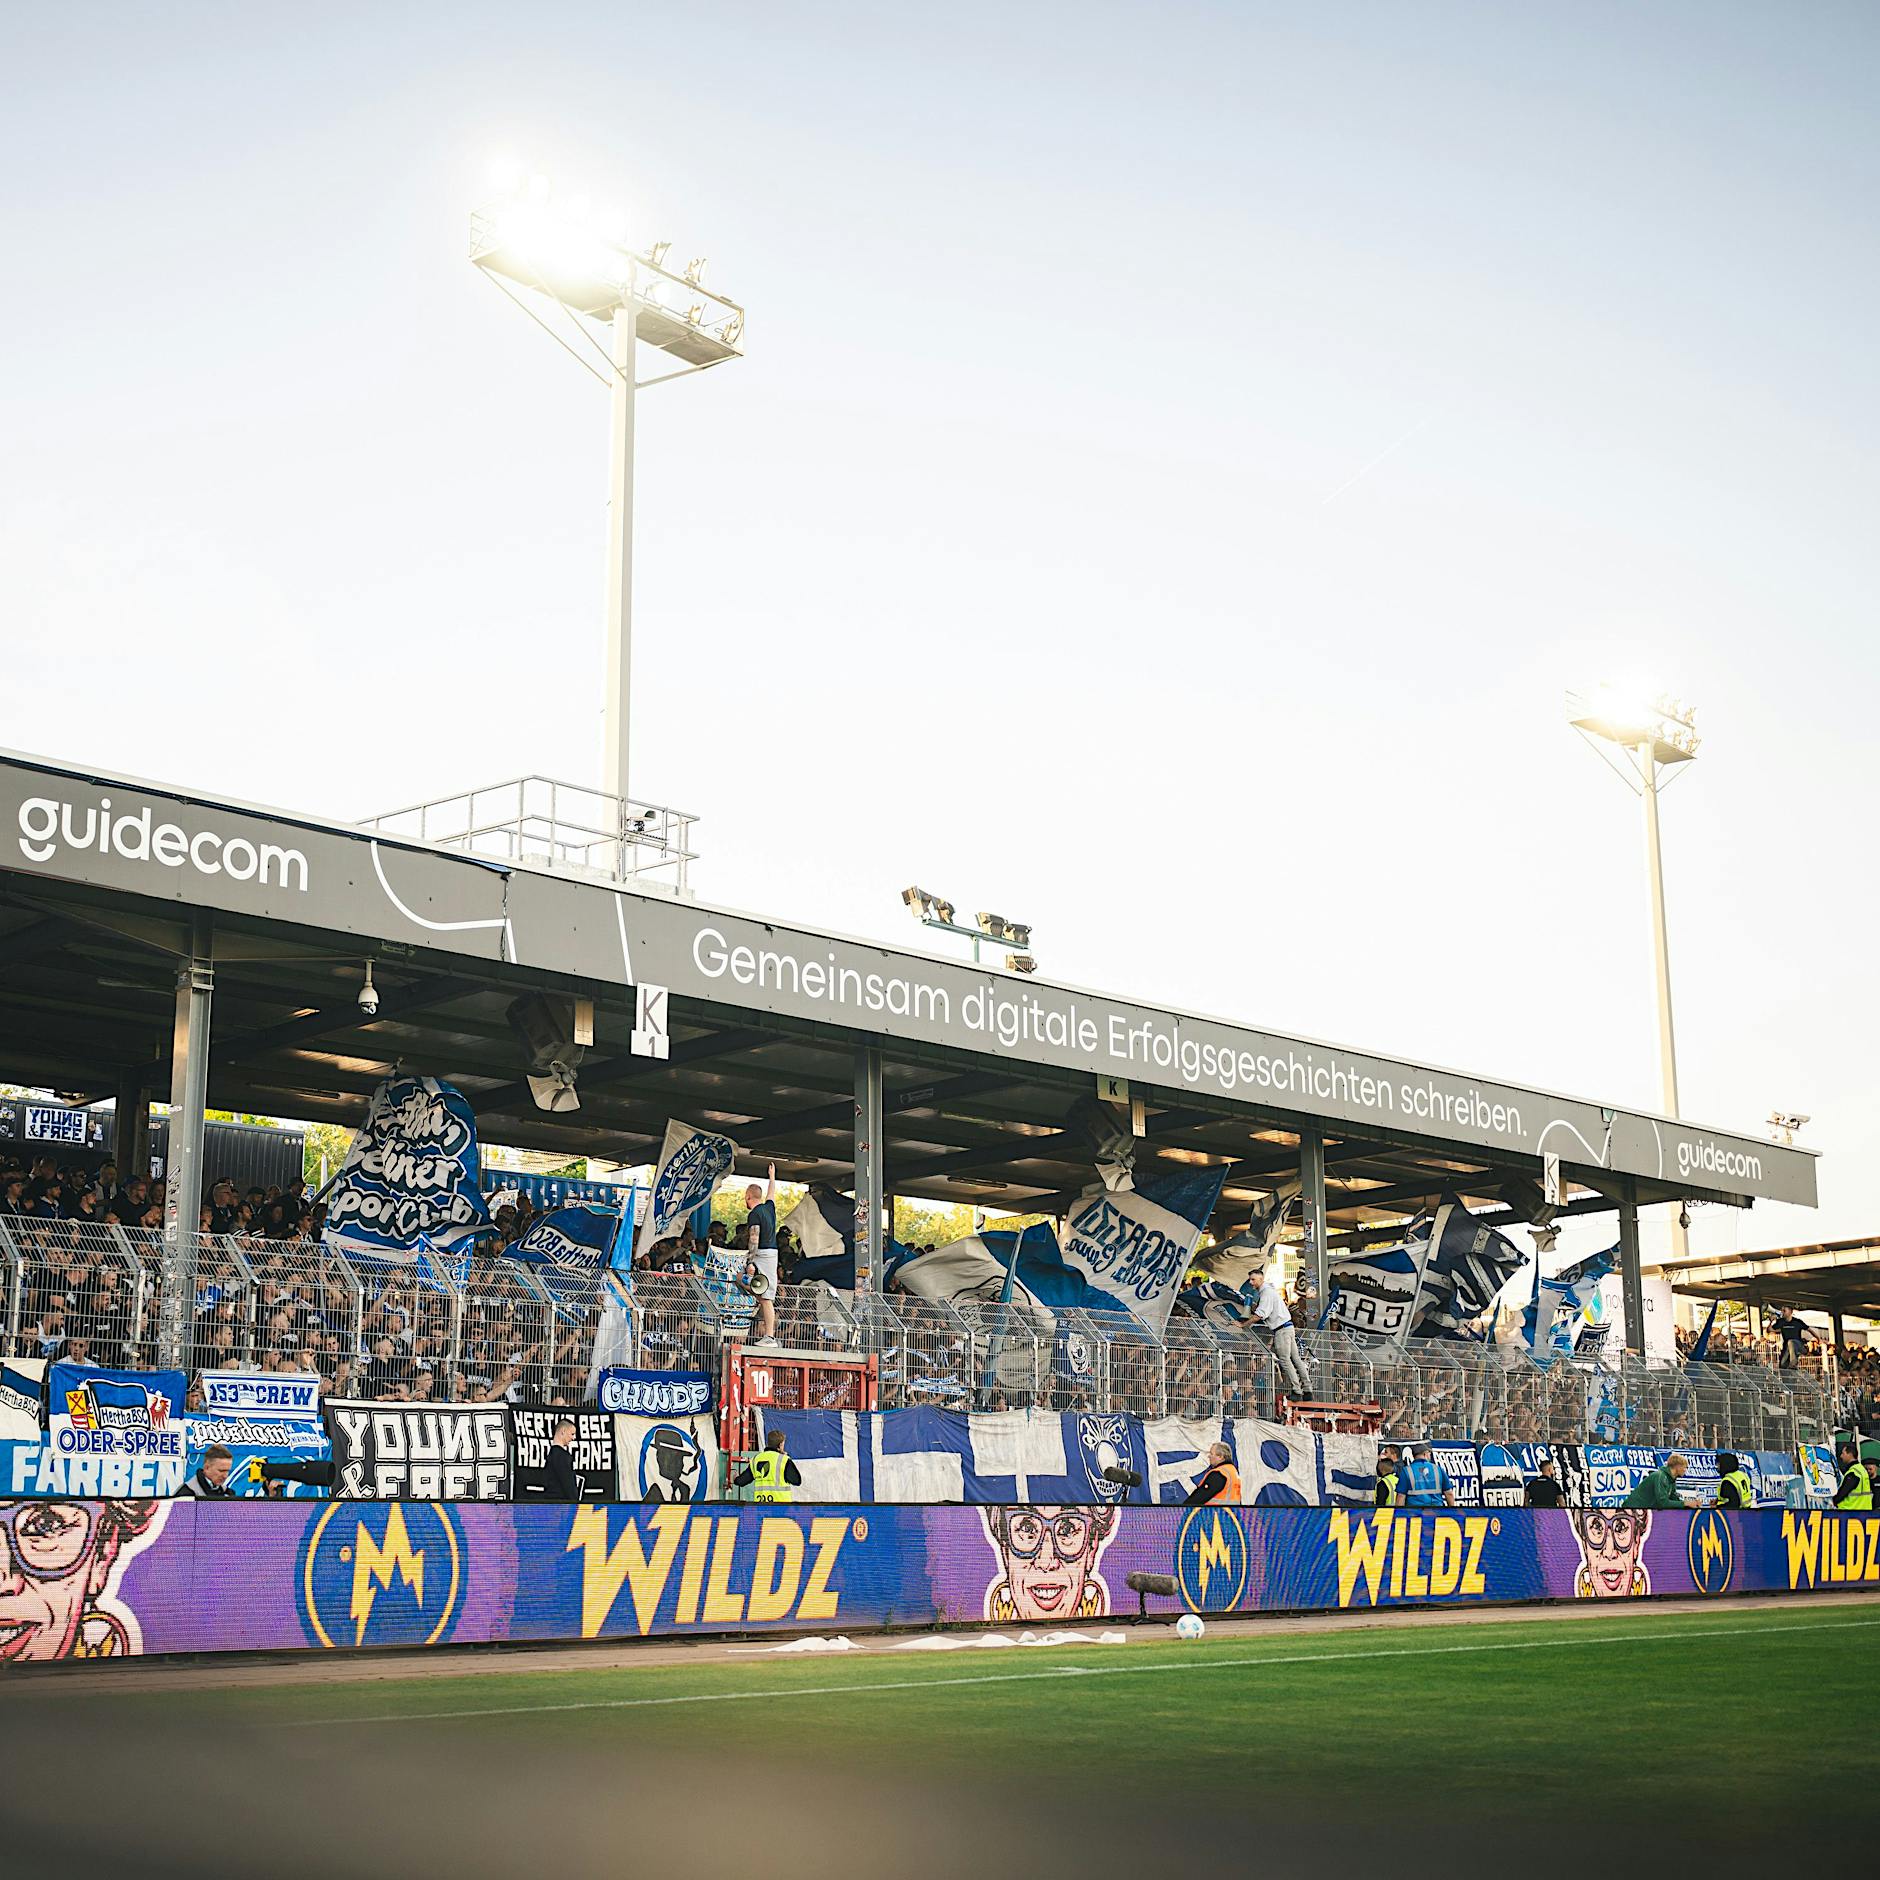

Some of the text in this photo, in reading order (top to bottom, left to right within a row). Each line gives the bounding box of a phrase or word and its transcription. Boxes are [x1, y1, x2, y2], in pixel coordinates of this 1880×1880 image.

[18, 796, 309, 891] guidecom
[643, 989, 664, 1034] K
[648, 1035, 656, 1057] 1
[692, 928, 1528, 1137] Gemeinsam digitale Erfolgsgeschichten schreiben.
[1108, 1080, 1118, 1096] K
[29, 1109, 83, 1128] YOUNG
[1546, 1157, 1557, 1189] K
[1677, 1141, 1763, 1181] guidecom
[209, 1383, 239, 1403] 153
[255, 1385, 314, 1406] CREW
[751, 1370, 769, 1398] 10
[101, 1408, 148, 1427] Hertha BSC
[578, 1414, 612, 1440] BSC
[57, 1428, 181, 1456] ODER-SPREE
[335, 1409, 507, 1461] YOUNG
